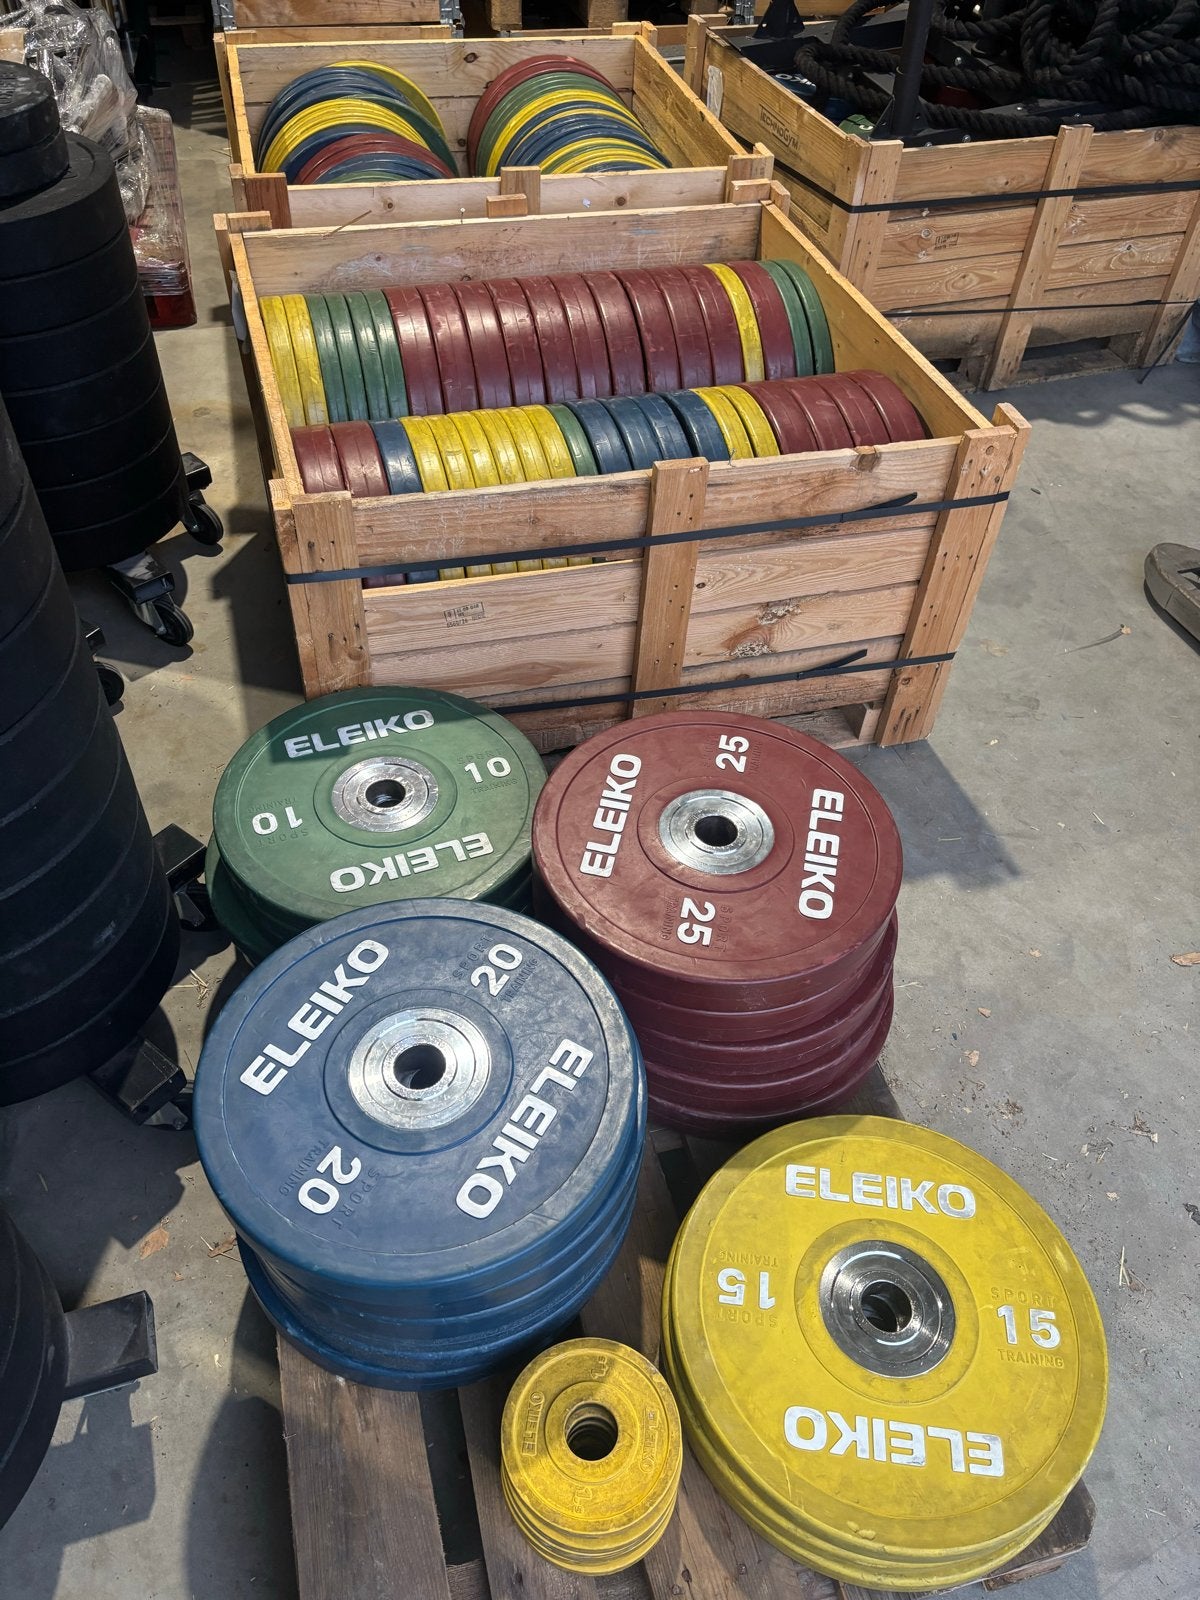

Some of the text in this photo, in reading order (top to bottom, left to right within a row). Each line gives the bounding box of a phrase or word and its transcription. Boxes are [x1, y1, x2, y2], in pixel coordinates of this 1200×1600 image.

[284, 709, 435, 759] ELEIKO
[715, 734, 749, 773] 25
[464, 757, 511, 783] 10
[252, 806, 303, 836] 10
[579, 753, 642, 878] ELEIKO
[330, 832, 494, 893] ELEIKO
[798, 788, 845, 920] ELEIKO
[677, 897, 716, 947] 25
[714, 904, 734, 952] SPORT
[452, 934, 495, 979] SPORT
[470, 943, 523, 997] 20
[239, 938, 389, 1096] ELEIKO
[455, 1038, 594, 1219] ELEIKO
[279, 1139, 329, 1197] TRAINING
[298, 1145, 362, 1215] 20
[785, 1163, 976, 1220] ELEIKO
[331, 1167, 380, 1230] SPORT
[717, 1267, 777, 1310] 15
[990, 1286, 1056, 1308] SPORT
[997, 1305, 1061, 1350] 15
[998, 1348, 1065, 1369] TRAINING
[522, 1391, 545, 1457] ELEIKO
[783, 1405, 1005, 1478] ELEIKO
